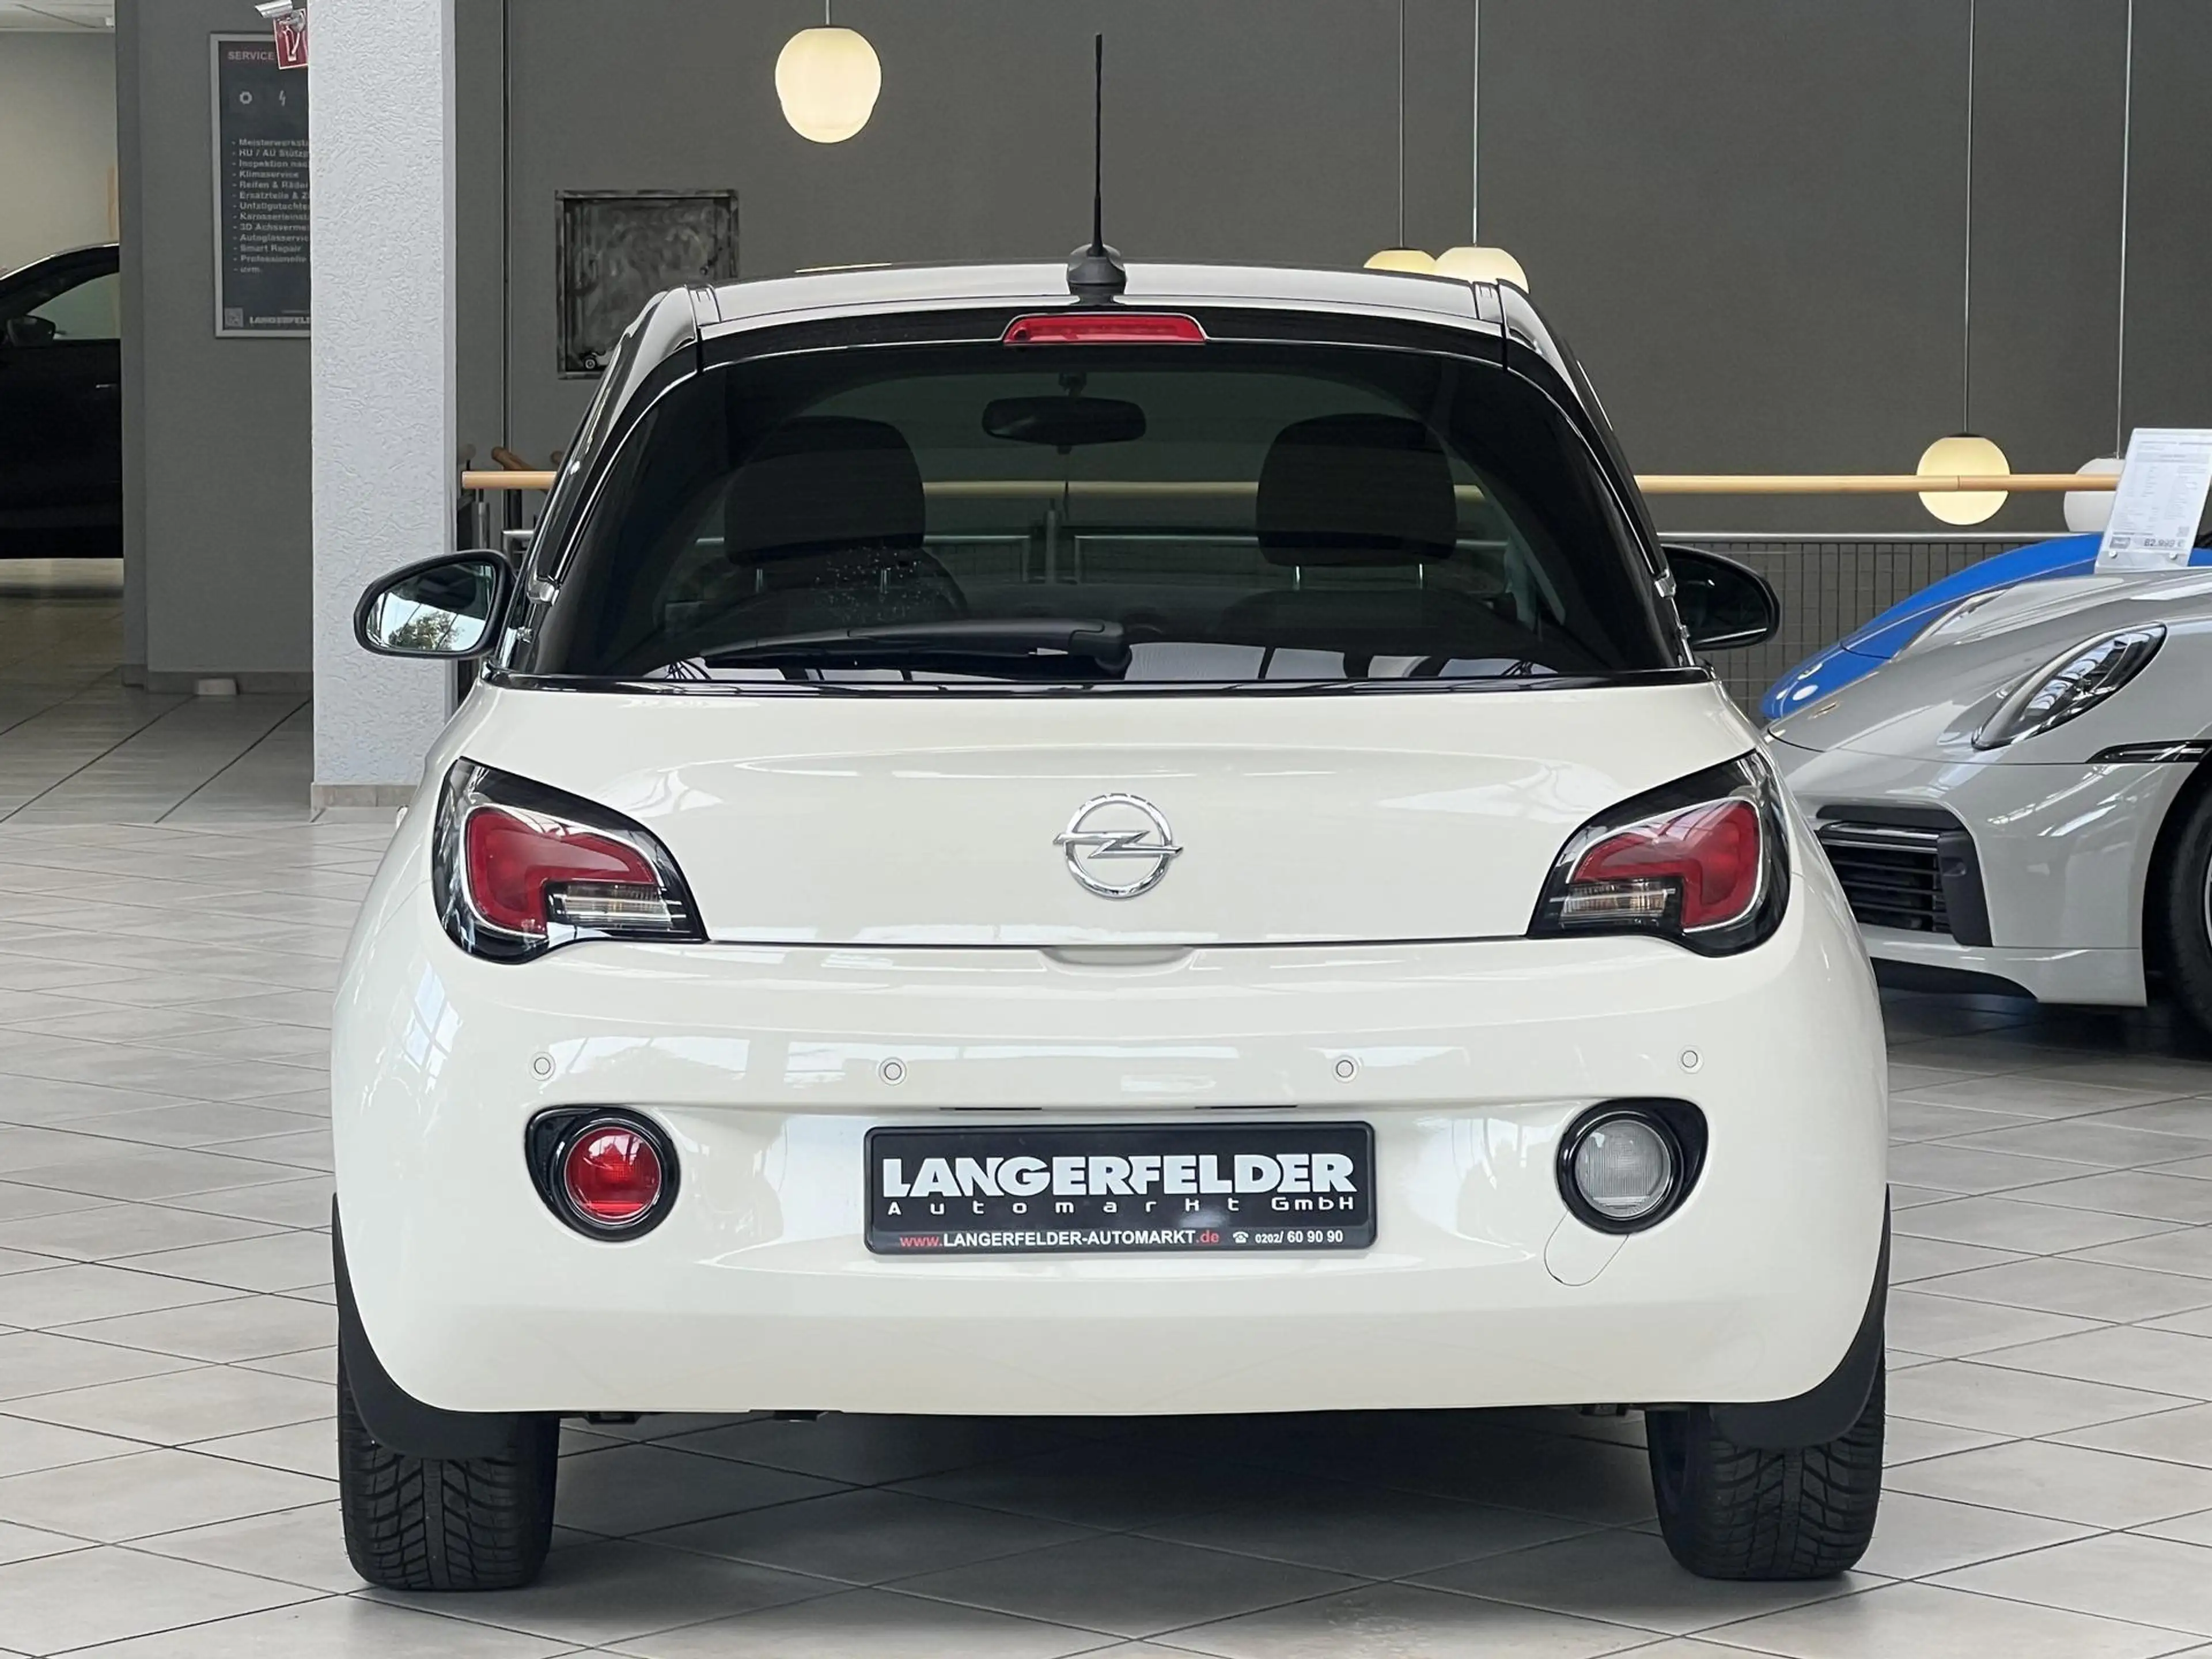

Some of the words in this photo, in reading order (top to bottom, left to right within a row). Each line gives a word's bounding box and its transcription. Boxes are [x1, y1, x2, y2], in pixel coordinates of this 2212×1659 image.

[228, 51, 275, 60] SERVICE
[239, 160, 289, 168] Inspektion
[240, 191, 289, 199] Ersatzteile
[240, 244, 268, 252] Smart
[271, 244, 301, 252] Repair
[882, 1153, 1358, 1197] LANGERFELDER
[888, 1198, 1240, 1215] Automarkt
[1271, 1196, 1354, 1211] GmbH
[900, 1230, 1220, 1248] www.LANGERFELDER-AUTOMARKT.de
[1255, 1231, 1284, 1244] 0202/
[1287, 1231, 1303, 1244] 60
[1307, 1230, 1323, 1244] 90
[1326, 1230, 1343, 1243] 90
